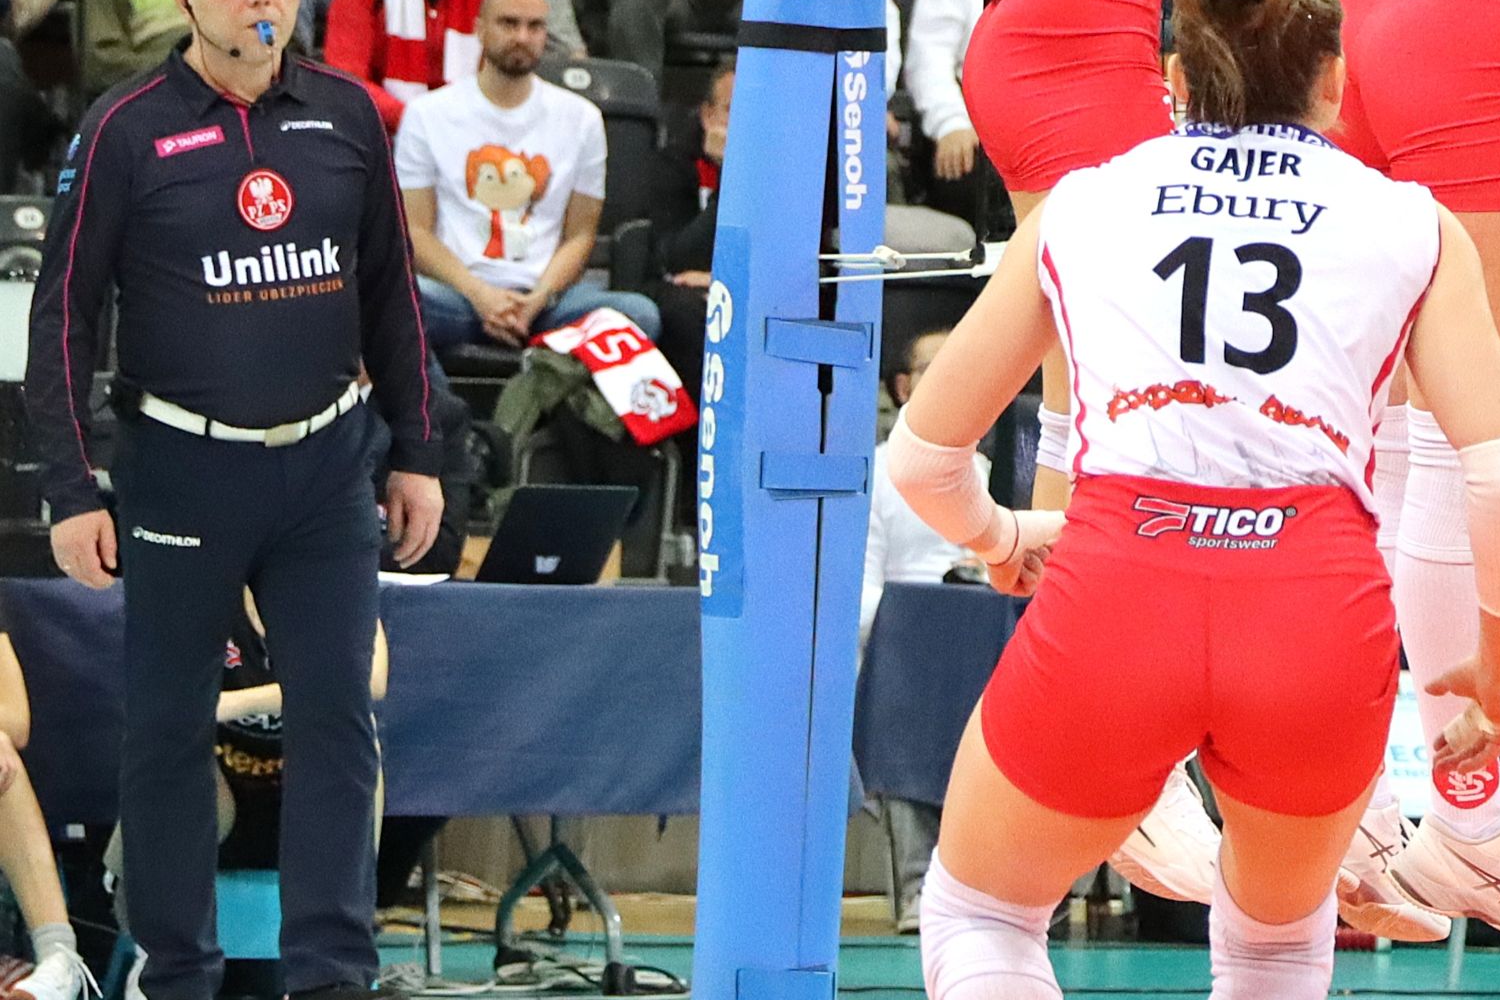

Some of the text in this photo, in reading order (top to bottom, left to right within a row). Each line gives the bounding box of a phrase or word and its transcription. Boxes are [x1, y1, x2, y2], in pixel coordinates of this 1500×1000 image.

[177, 131, 217, 147] TAURON
[844, 72, 867, 210] Senoh
[1190, 146, 1303, 182] GAJER
[1151, 184, 1328, 235] Ebury
[202, 238, 340, 286] Unilink
[207, 290, 252, 304] LIDER
[1152, 236, 1303, 375] 13
[1190, 506, 1285, 537] TICO
[1188, 535, 1278, 549] sportswear
